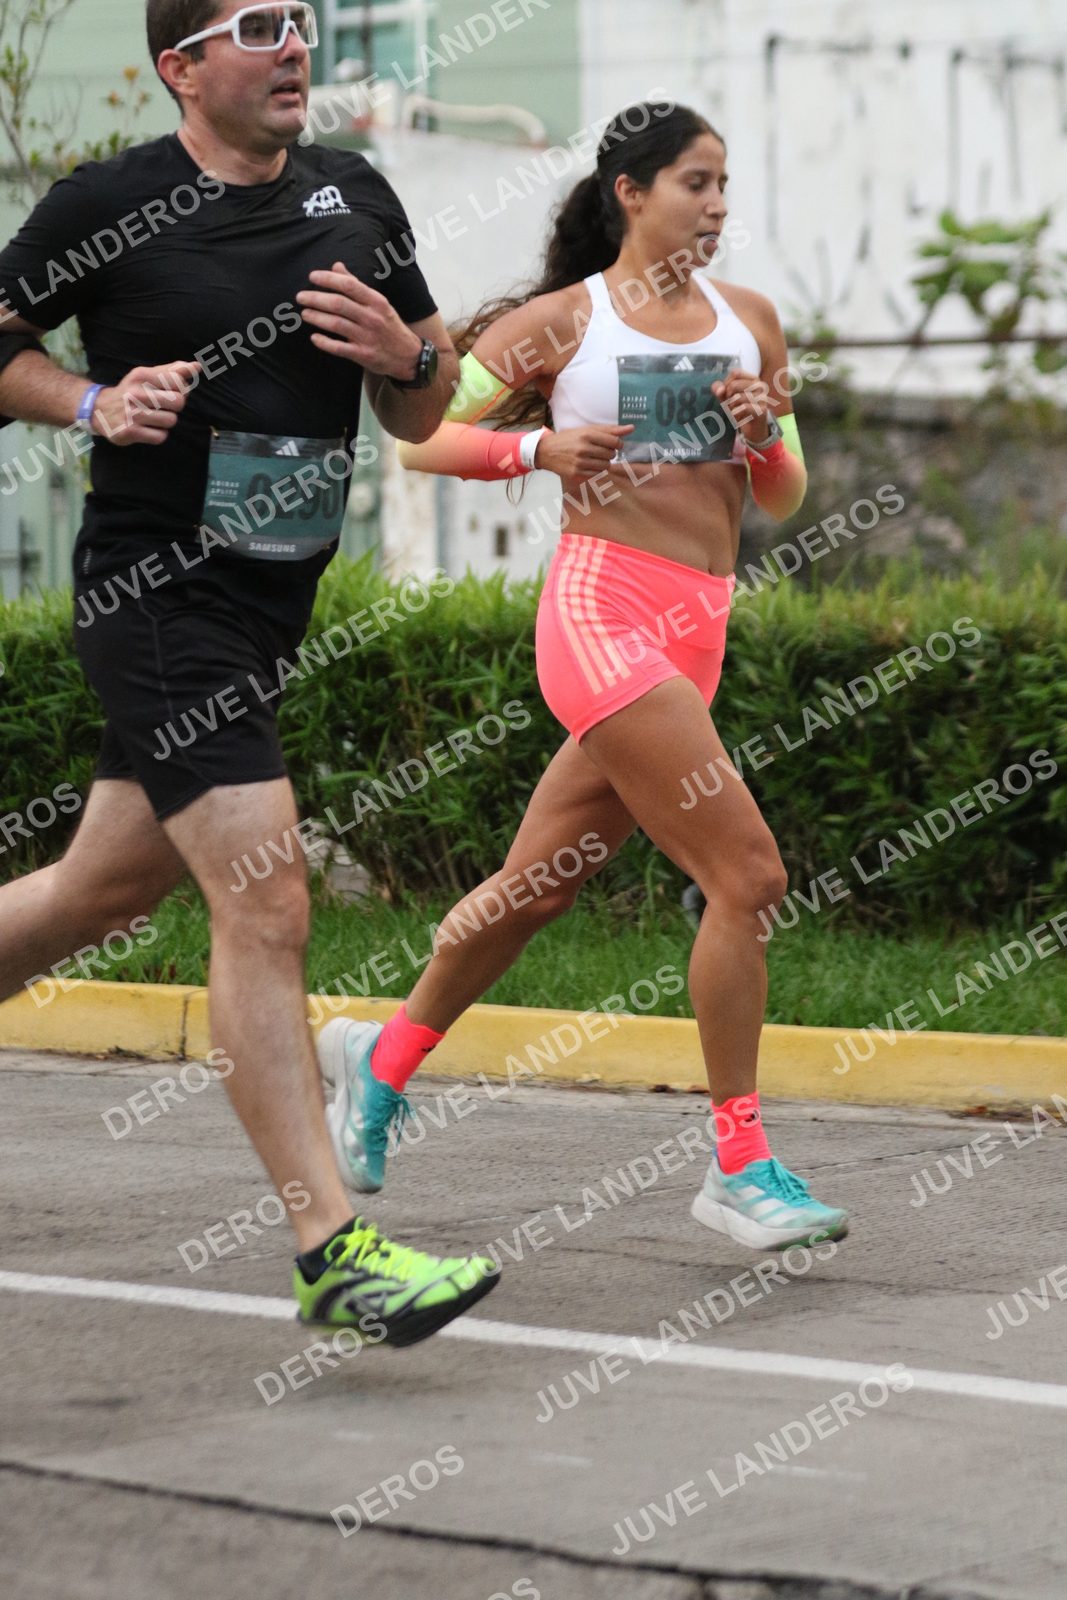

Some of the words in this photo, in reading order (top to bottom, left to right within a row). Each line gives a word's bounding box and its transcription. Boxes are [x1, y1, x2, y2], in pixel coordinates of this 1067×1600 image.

[655, 386, 716, 427] 087
[664, 448, 702, 456] SAMSUNG
[248, 542, 296, 552] SAMSUNG
